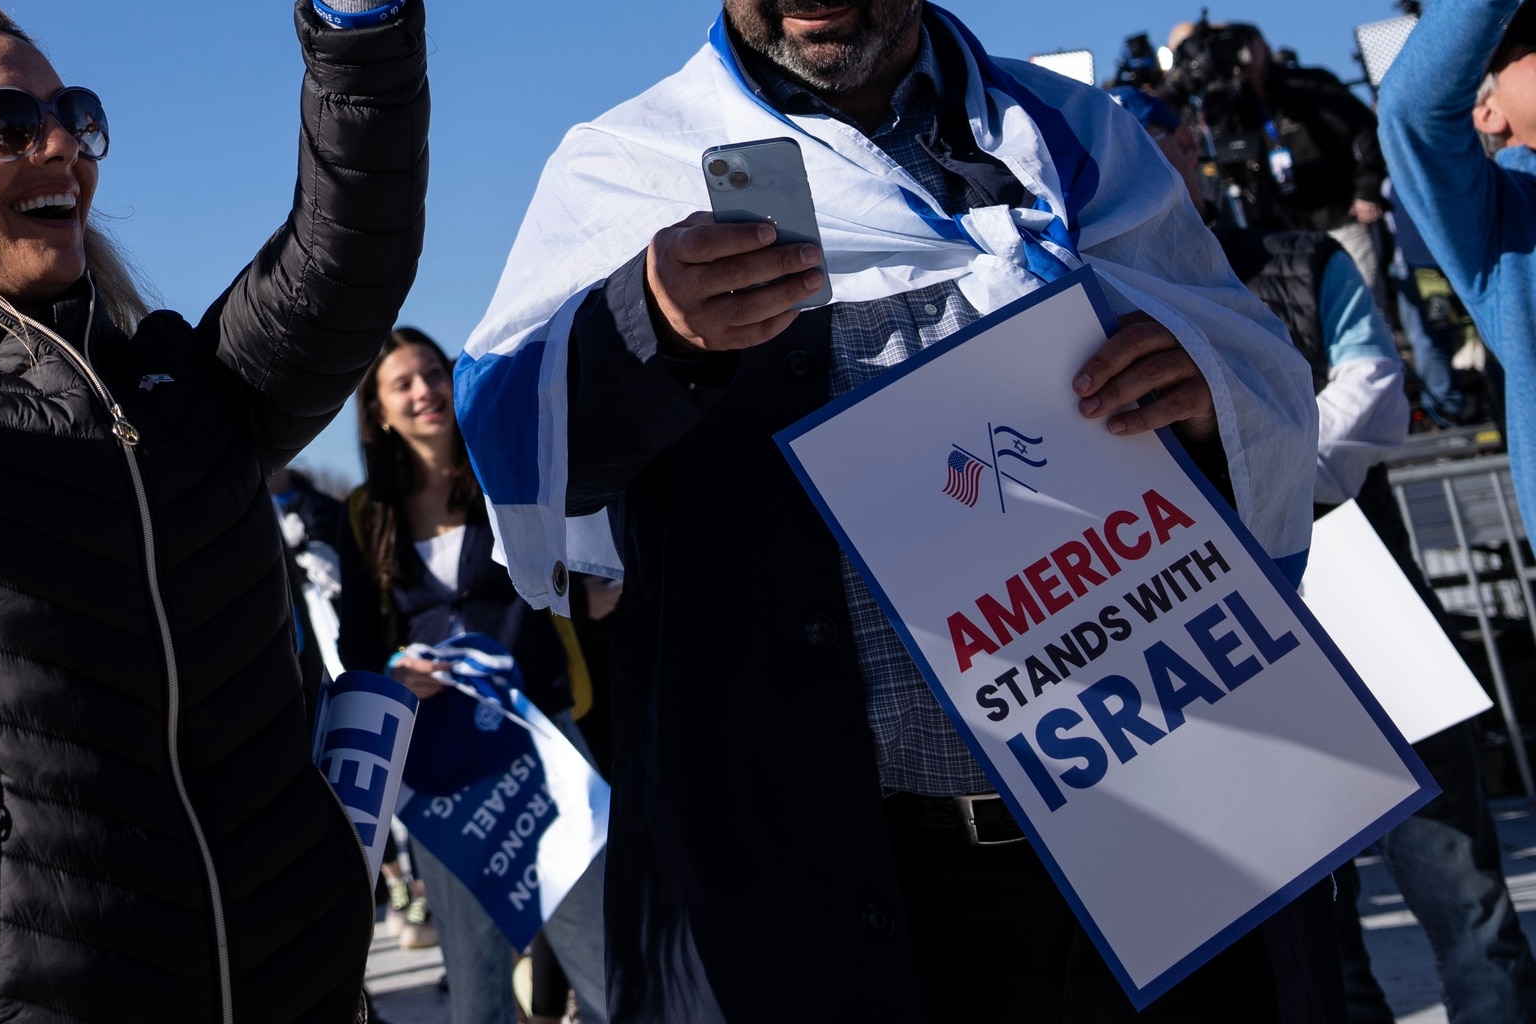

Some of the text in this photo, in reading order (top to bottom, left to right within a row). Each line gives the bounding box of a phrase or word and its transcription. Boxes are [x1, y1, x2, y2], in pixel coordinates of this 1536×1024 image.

[946, 488, 1196, 673] AMERICA
[975, 539, 1232, 723] STANDS WITH
[1005, 589, 1302, 813] ISRAEL
[460, 752, 537, 841] ISRAEL
